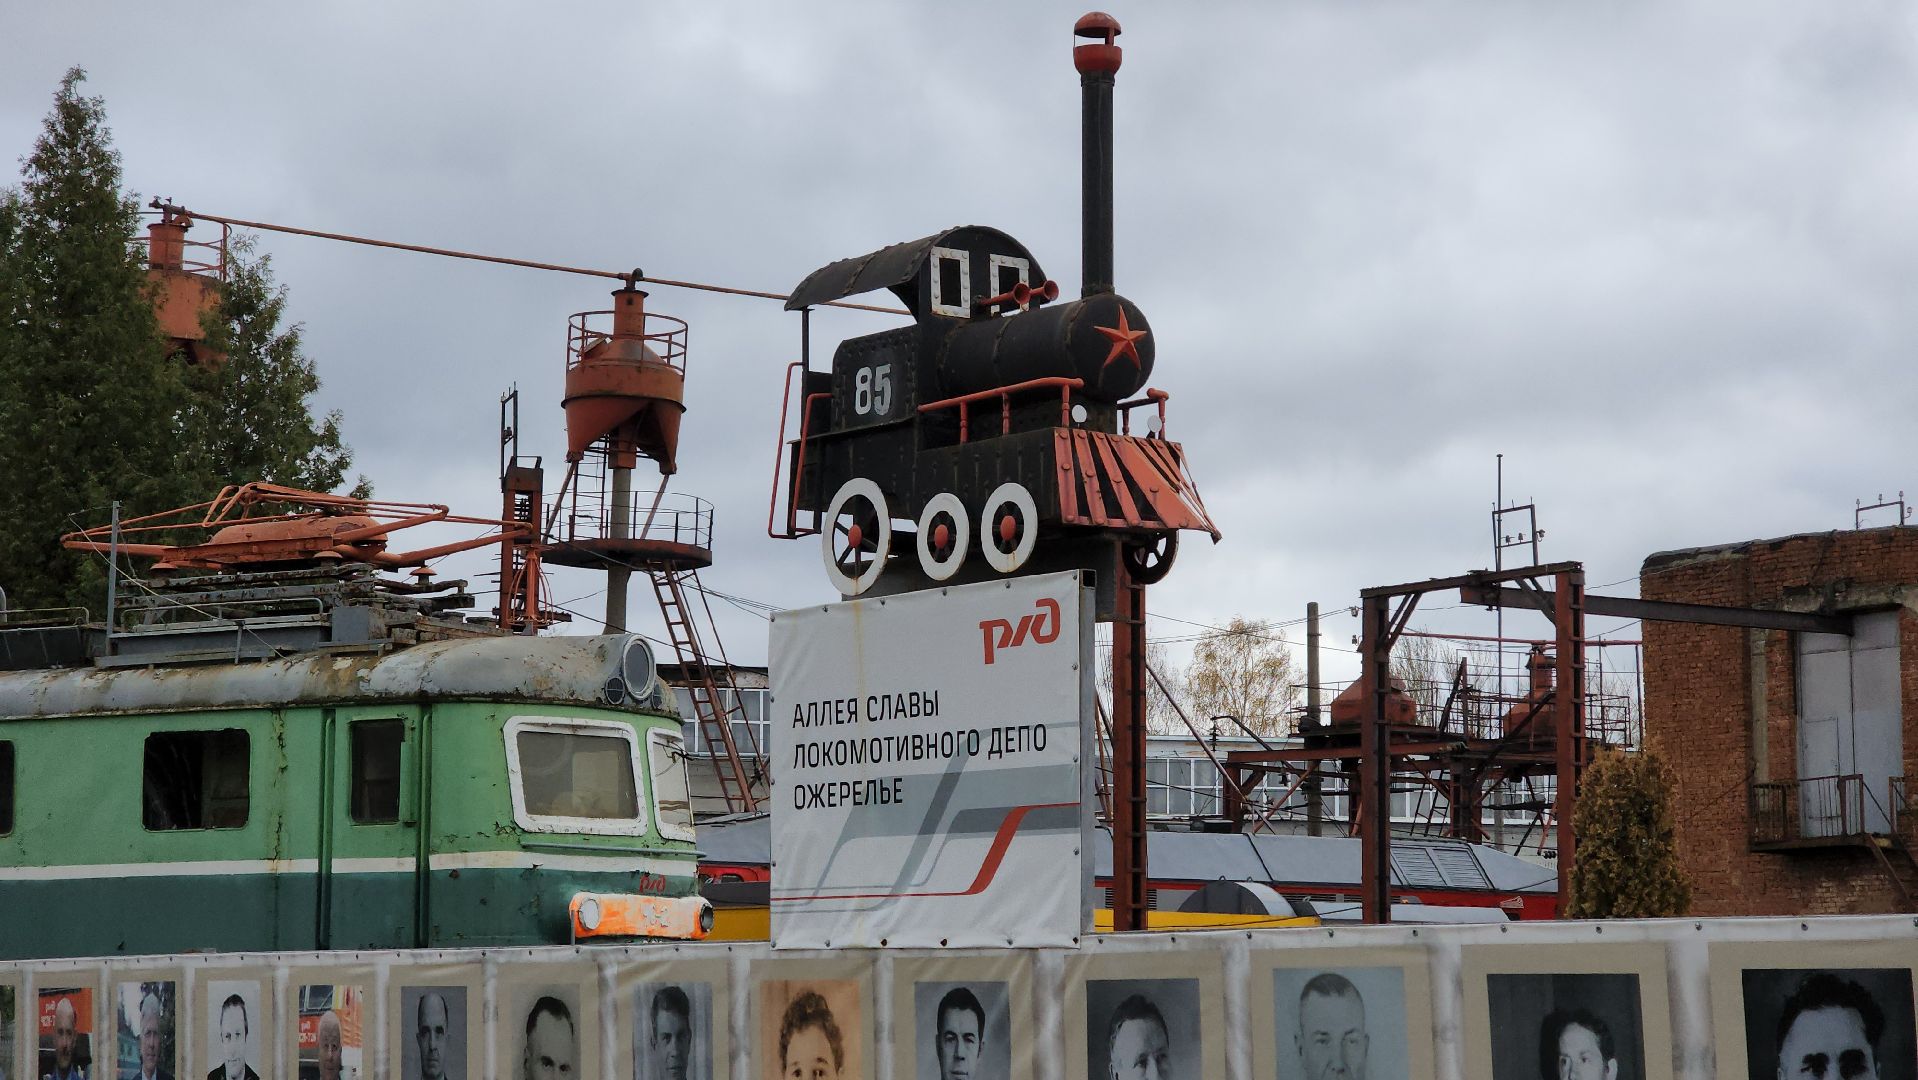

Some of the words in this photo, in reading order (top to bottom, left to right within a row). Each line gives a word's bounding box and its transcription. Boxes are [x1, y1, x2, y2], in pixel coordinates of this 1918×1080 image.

[855, 363, 892, 415] 85
[793, 698, 858, 728] АЛЛЕЯ
[867, 690, 939, 722] СЛАВЫ
[793, 728, 980, 769] ЛОКОМОТИВНОГО
[988, 724, 1047, 759] ДЕПО
[794, 777, 903, 810] ОЖЕРЕЛЬЕ
